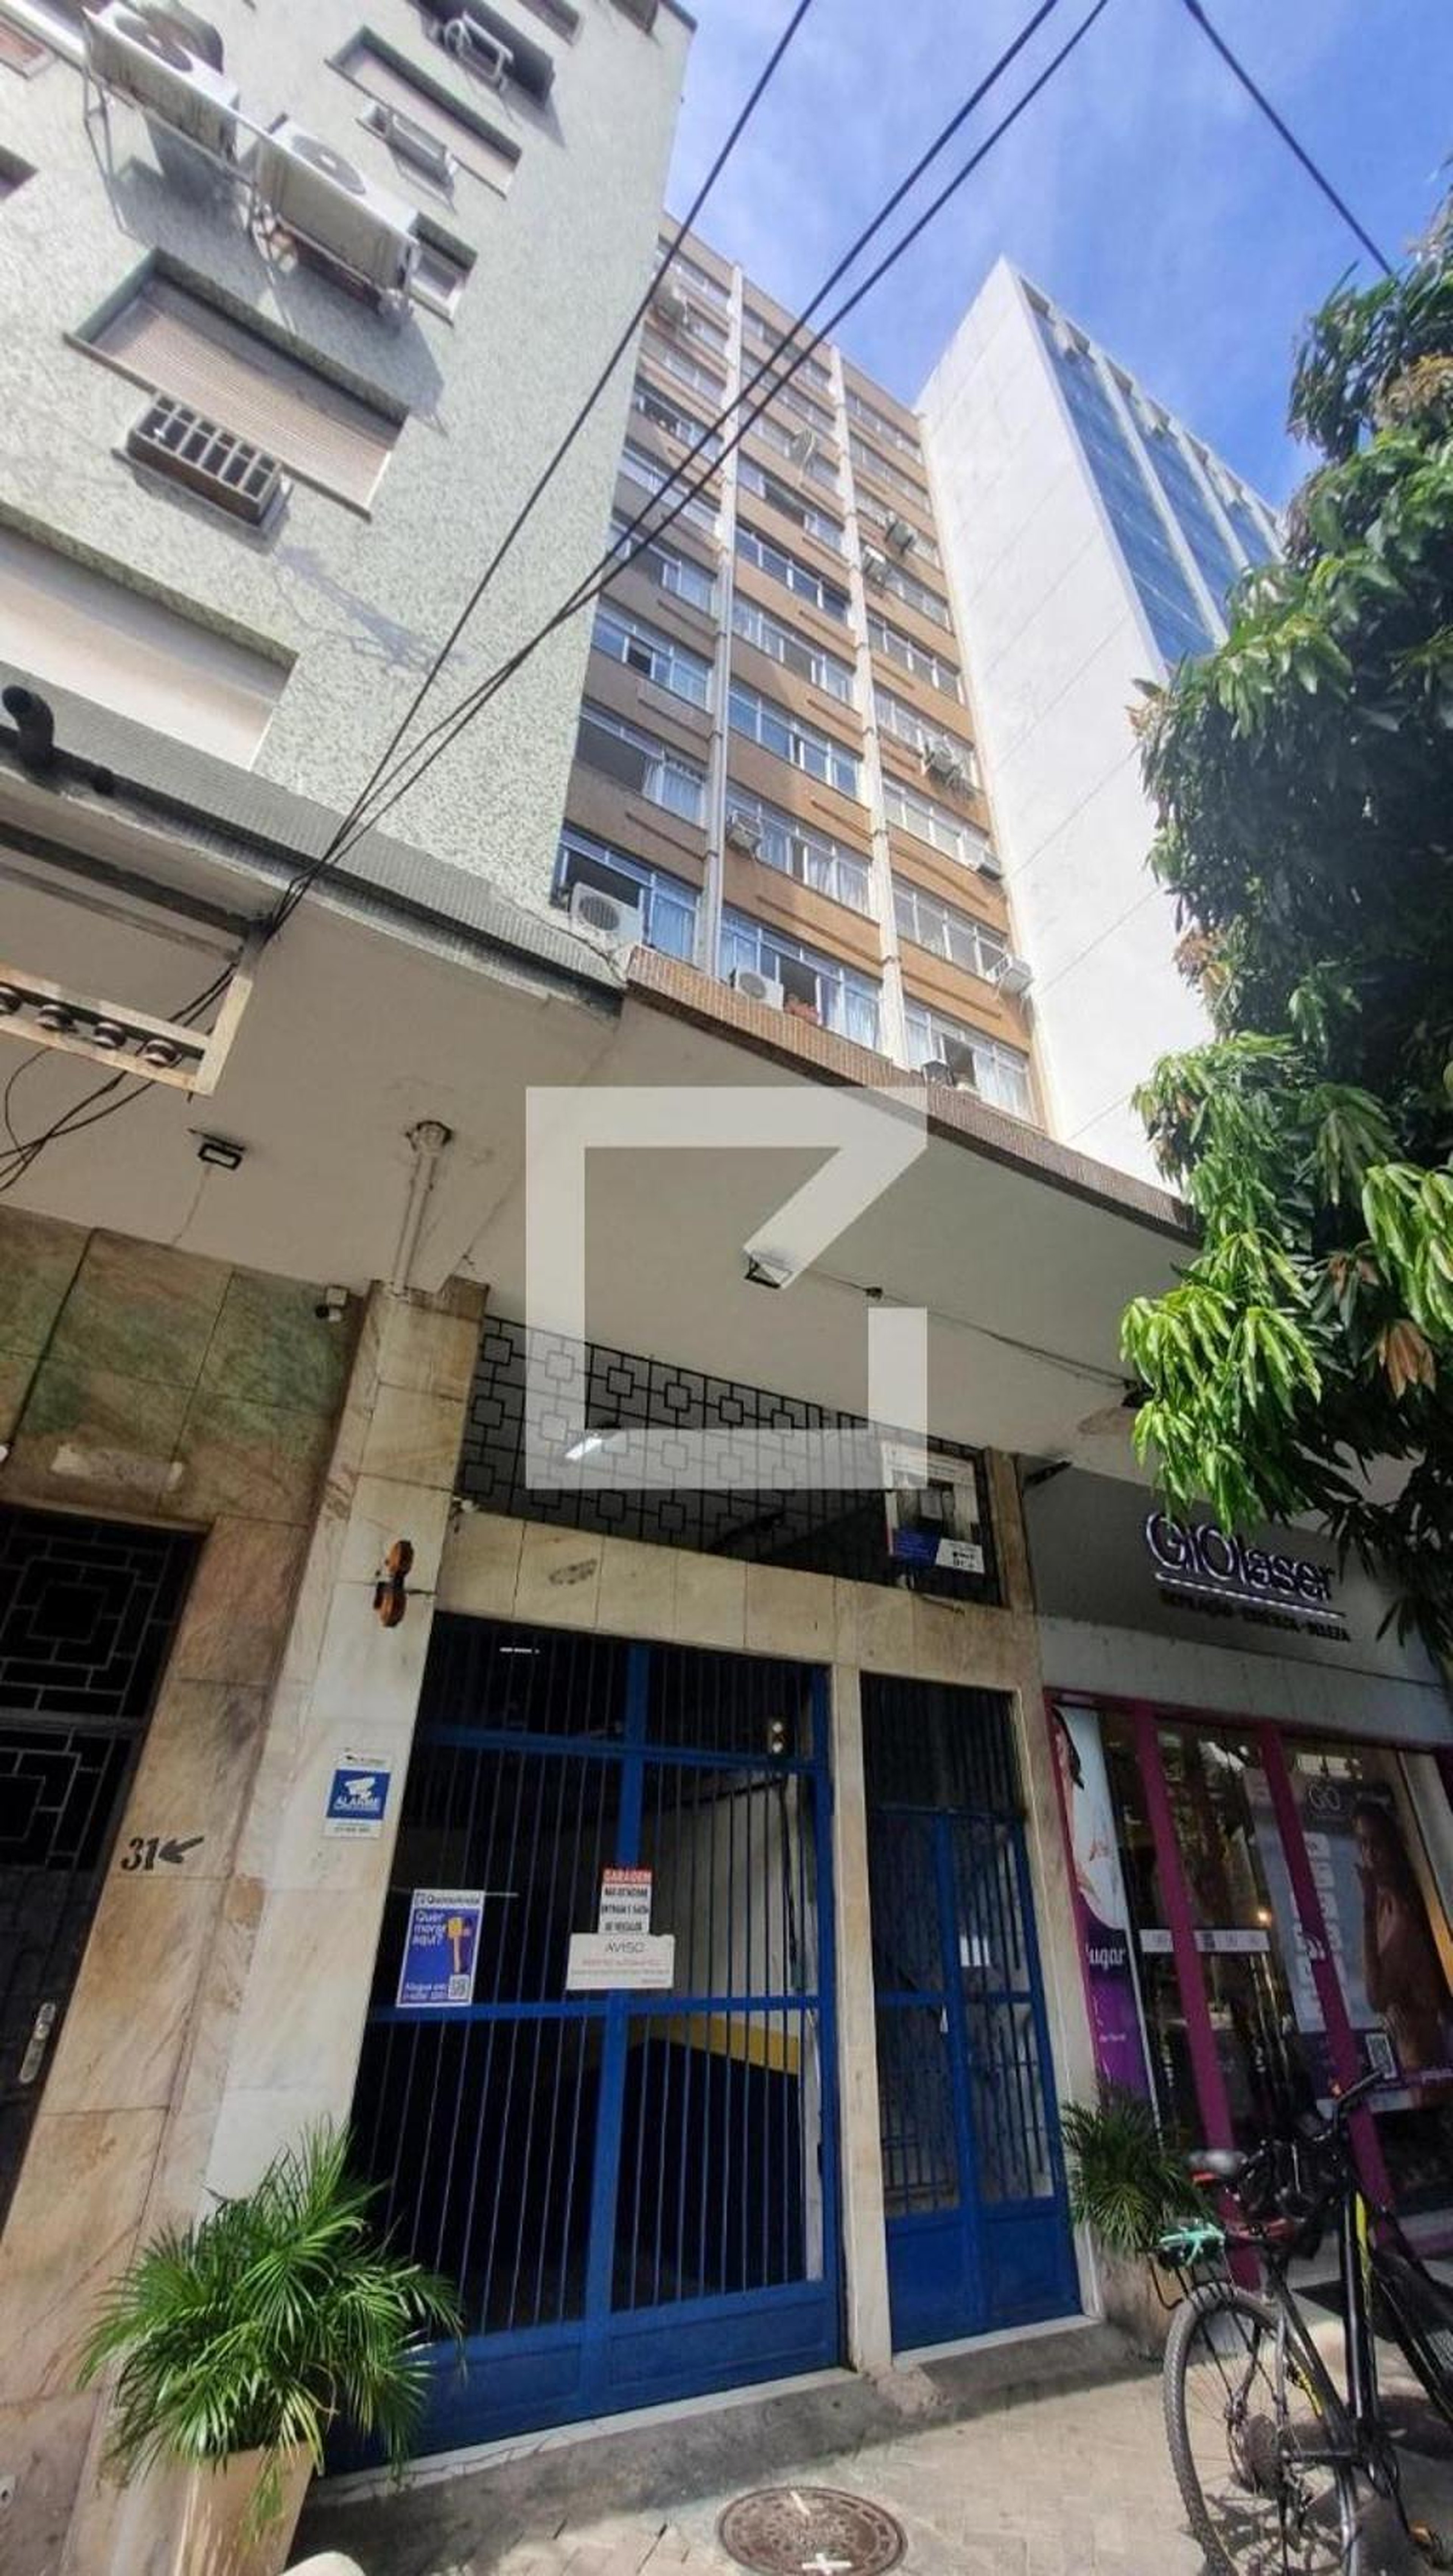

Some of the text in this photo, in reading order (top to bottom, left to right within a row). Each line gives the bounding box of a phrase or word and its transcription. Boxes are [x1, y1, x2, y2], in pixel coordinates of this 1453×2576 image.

[120, 1836, 159, 1871] 31
[416, 1911, 443, 1923] Quer
[414, 1923, 447, 1934] morar
[412, 1933, 443, 1947] aqui?
[606, 1941, 646, 1953] AVISO
